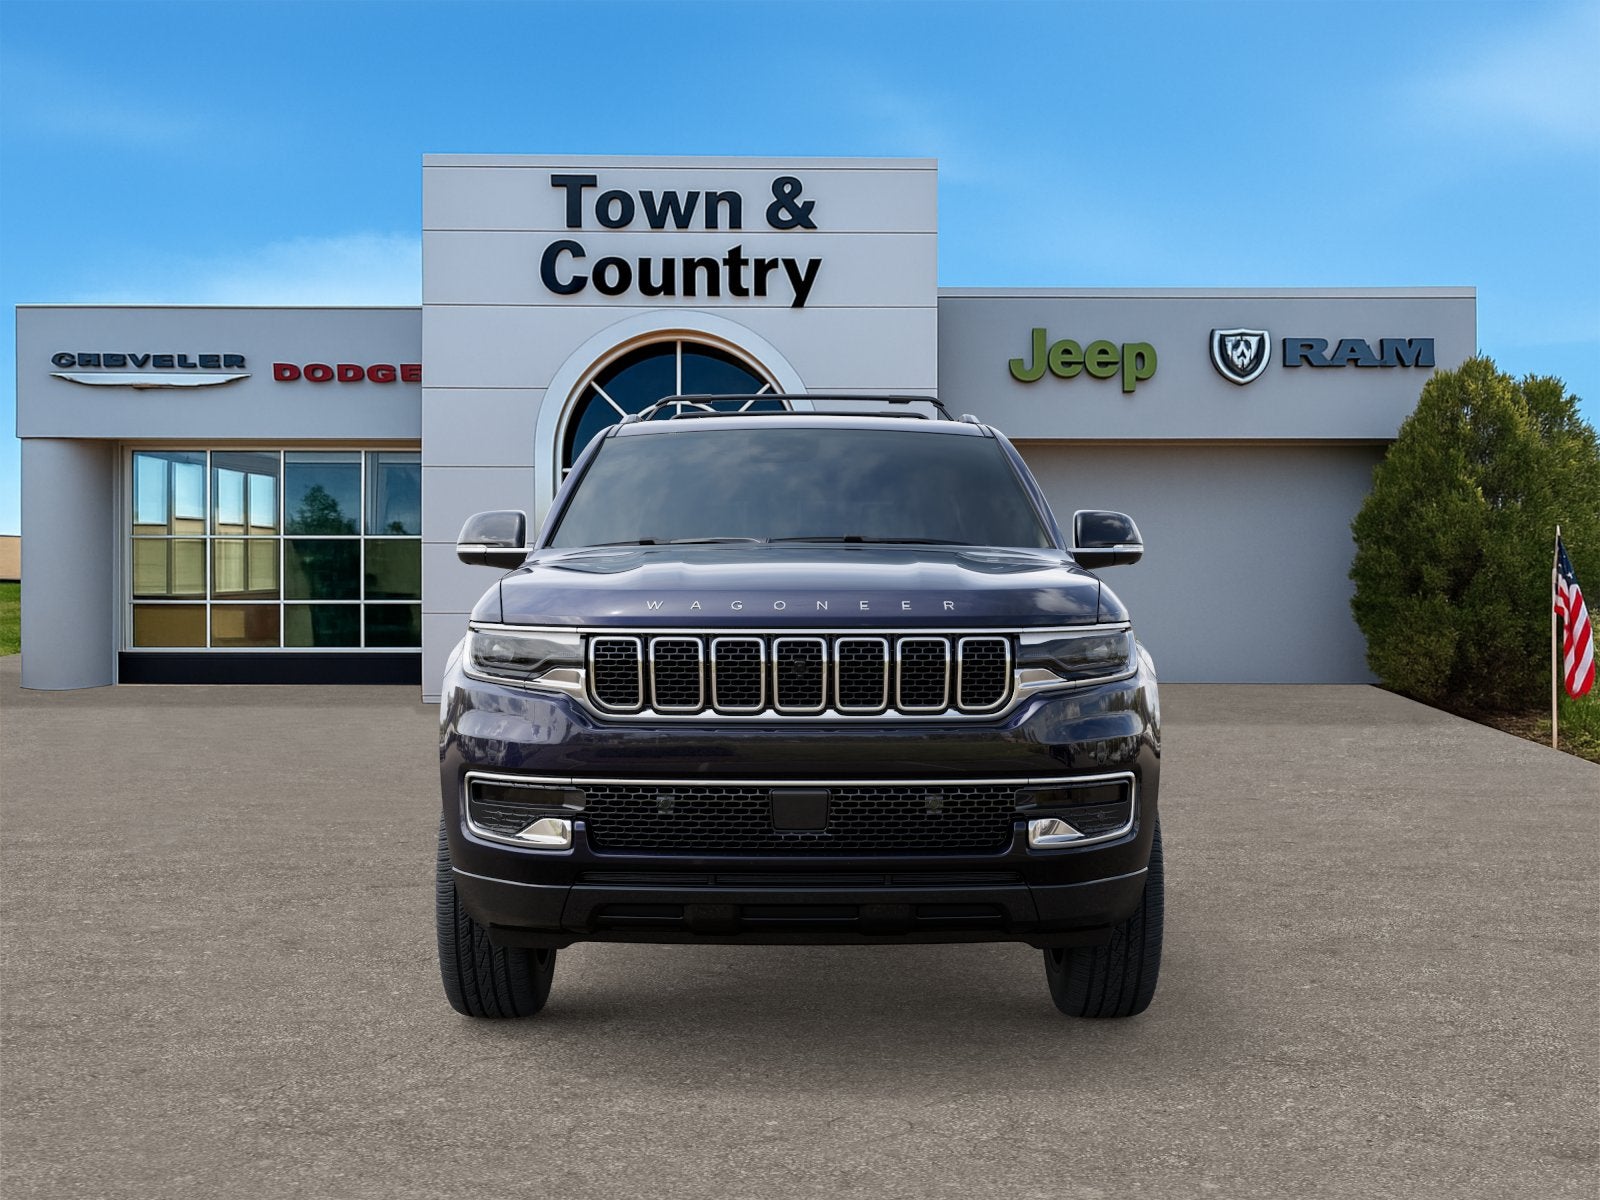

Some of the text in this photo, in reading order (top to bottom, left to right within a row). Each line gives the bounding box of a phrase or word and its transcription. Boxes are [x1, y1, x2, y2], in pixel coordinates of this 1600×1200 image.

[551, 174, 817, 229] Town &
[541, 240, 822, 308] Country
[273, 362, 422, 383] DODGE
[1009, 328, 1157, 392] Jeep
[1283, 337, 1435, 367] RAM
[646, 600, 955, 611] WAGONEER
